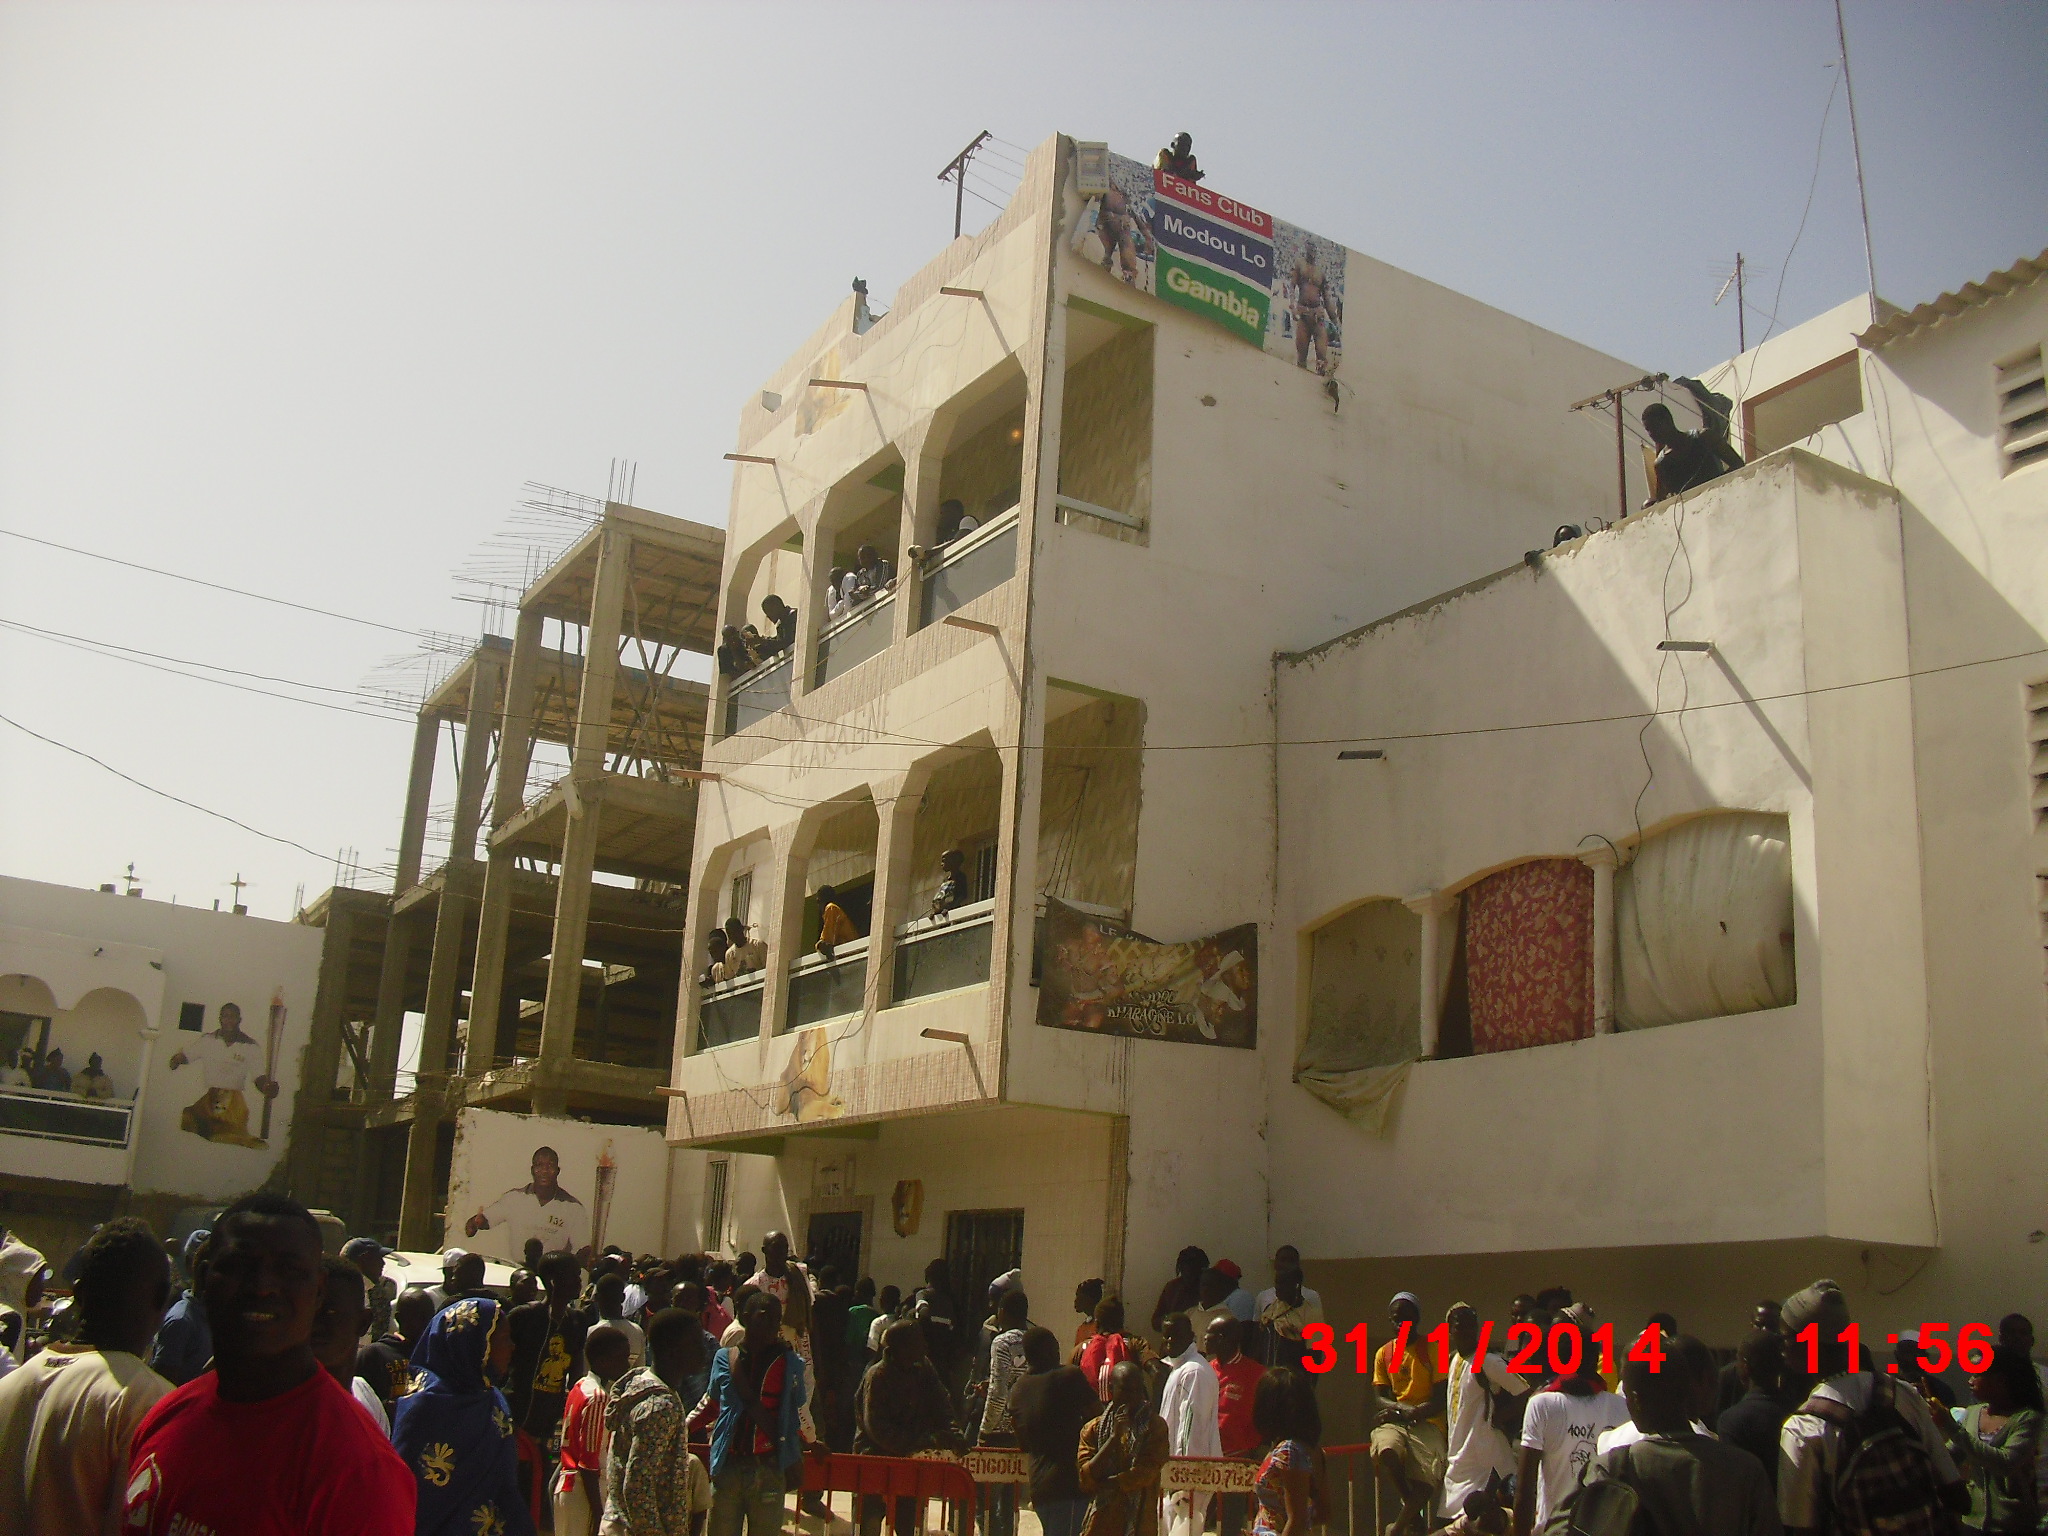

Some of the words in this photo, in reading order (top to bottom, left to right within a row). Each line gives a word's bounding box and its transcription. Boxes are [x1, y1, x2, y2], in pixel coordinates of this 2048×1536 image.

[1163, 173, 1211, 206] Fans
[1217, 190, 1265, 228] Club
[1165, 214, 1235, 256] Modou
[1241, 244, 1267, 269] Lo
[1165, 266, 1260, 330] Gambia
[1568, 1423, 1596, 1440] 100%
